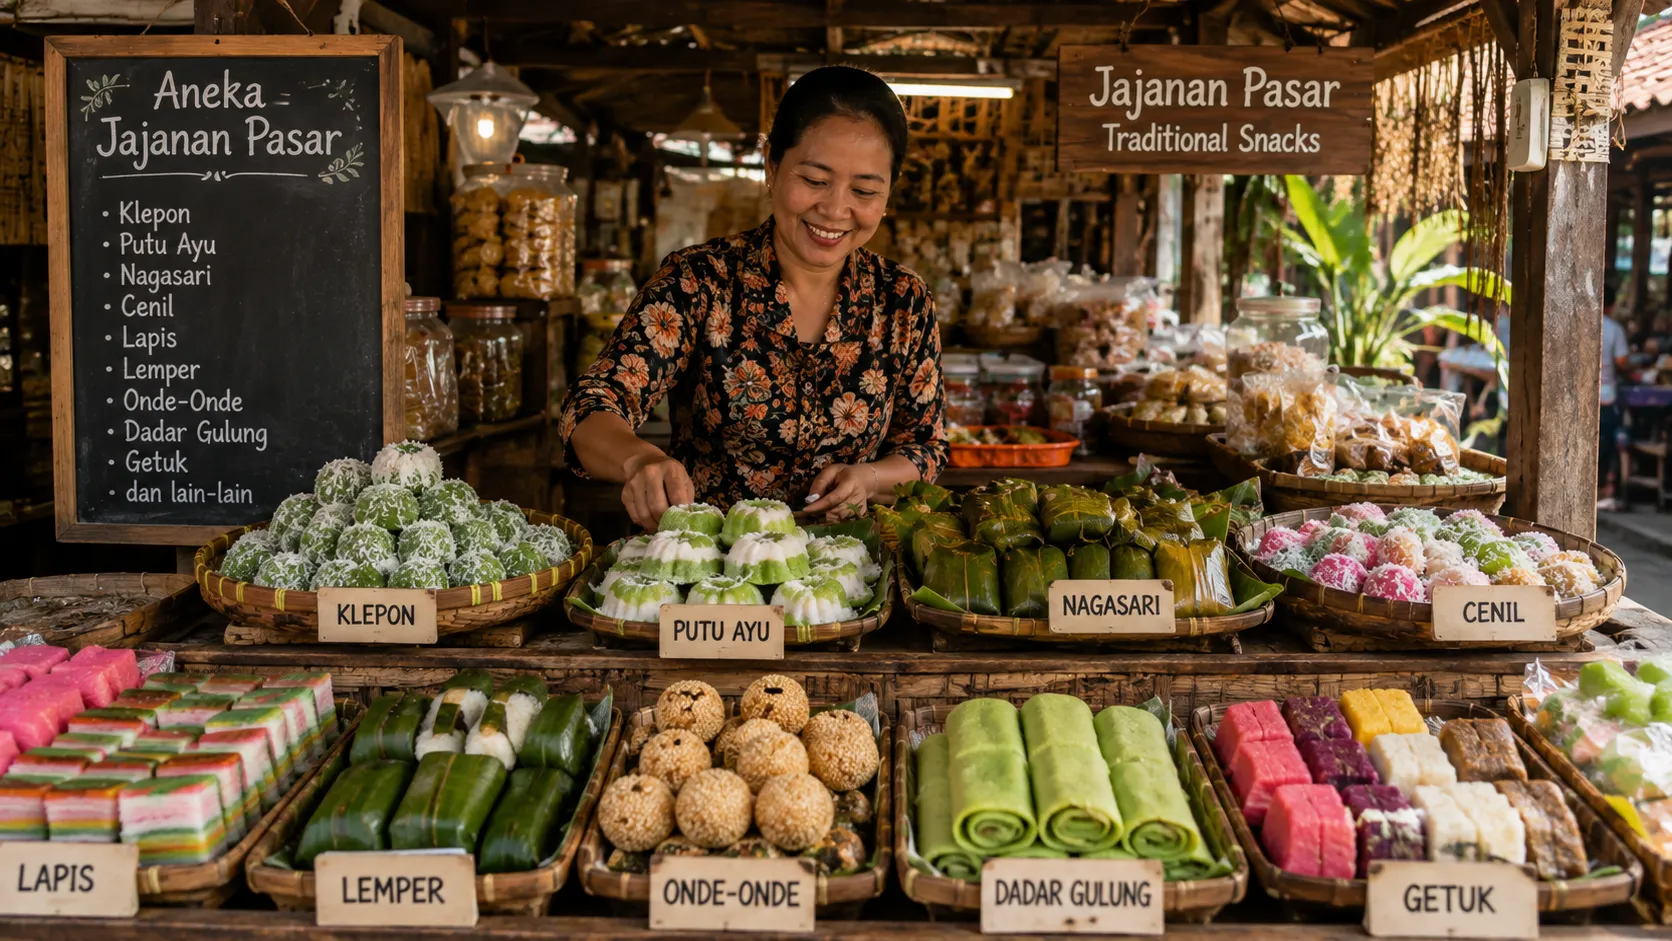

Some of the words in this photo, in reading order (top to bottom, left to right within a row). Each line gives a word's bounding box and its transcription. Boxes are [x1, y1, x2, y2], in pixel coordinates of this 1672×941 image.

[154, 69, 266, 110] Aneka
[1089, 65, 1228, 121] Jajanan
[1243, 66, 1341, 108] Pasar
[96, 116, 232, 170] Jajanan
[245, 115, 342, 156] Pasar
[1102, 122, 1228, 152] Traditional
[1238, 123, 1321, 153] Snacks
[119, 200, 190, 231] Klepon
[120, 232, 167, 255] Putu
[176, 232, 216, 263] Ayu
[121, 263, 211, 293] Nagasari
[121, 294, 174, 317] Cenil
[123, 325, 177, 356] Lapis
[123, 357, 201, 387] Lemper
[123, 388, 243, 412] Onde-Onde
[125, 419, 187, 442] Dadar
[197, 420, 268, 451] Gulung
[125, 450, 189, 473] Getuk
[126, 480, 162, 503] dan
[171, 481, 253, 504] lain-lain
[337, 604, 415, 626] KLEPON
[1063, 594, 1160, 616] NAGASARI
[1463, 601, 1525, 624] CENIL
[673, 619, 724, 642] PUTU
[733, 620, 770, 642] AYU
[18, 864, 95, 893] LAPIS
[342, 876, 446, 905] LEMPER
[664, 878, 800, 908] ONDE-ONDE
[995, 879, 1063, 906] DADAR
[1070, 880, 1152, 908] GULUNG
[1403, 884, 1496, 913] GETUK
